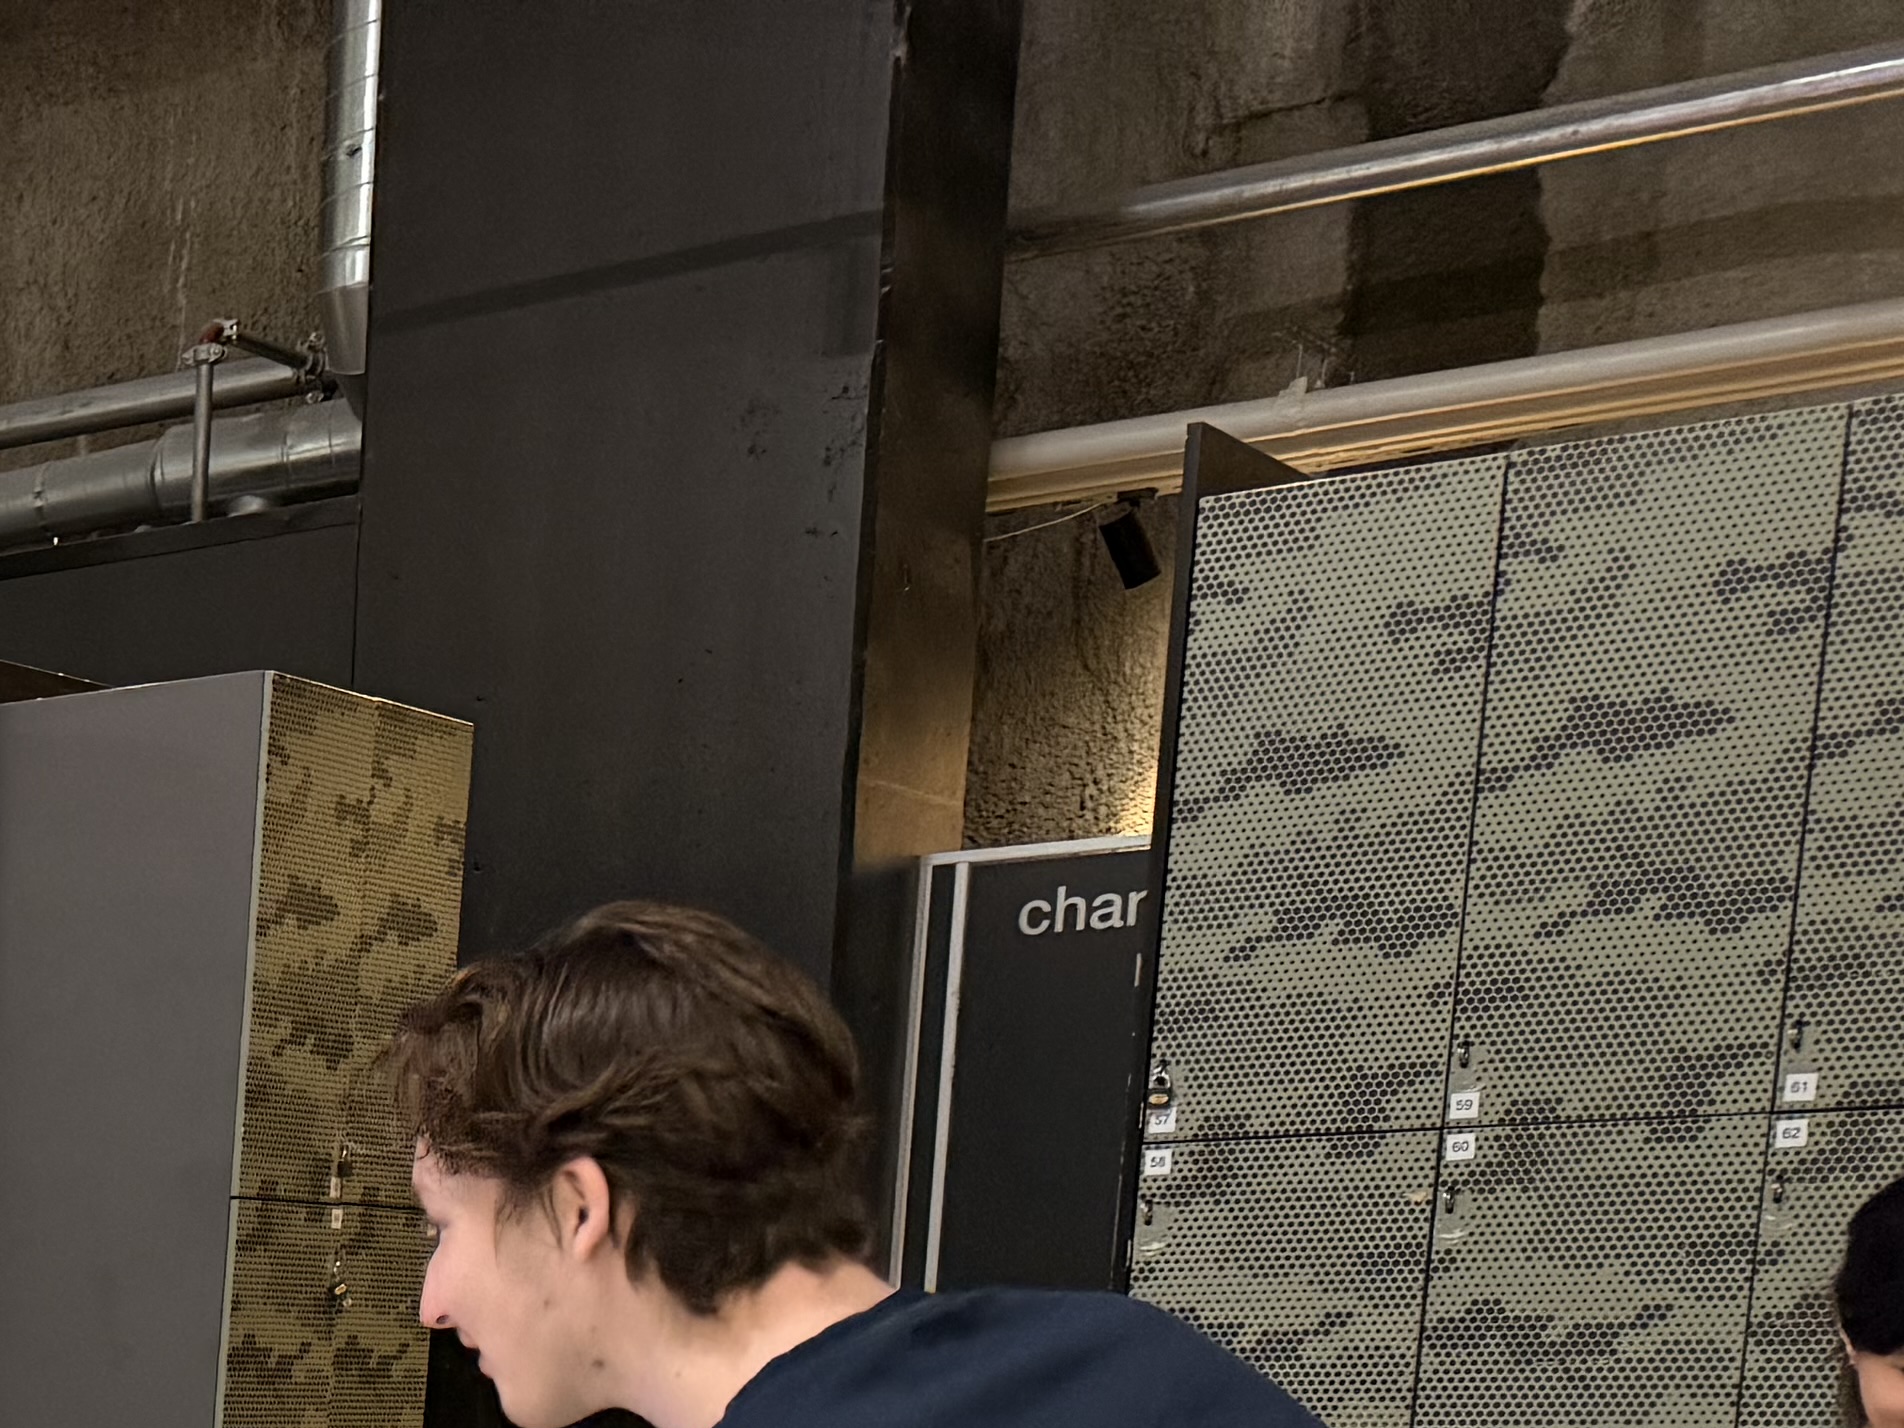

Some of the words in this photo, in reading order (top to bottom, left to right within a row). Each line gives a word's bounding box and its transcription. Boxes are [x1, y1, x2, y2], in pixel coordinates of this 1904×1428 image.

[1790, 1081, 1808, 1094] 61
[1456, 1099, 1473, 1111] 59
[1782, 1127, 1801, 1139] 62
[1452, 1141, 1469, 1153] 60
